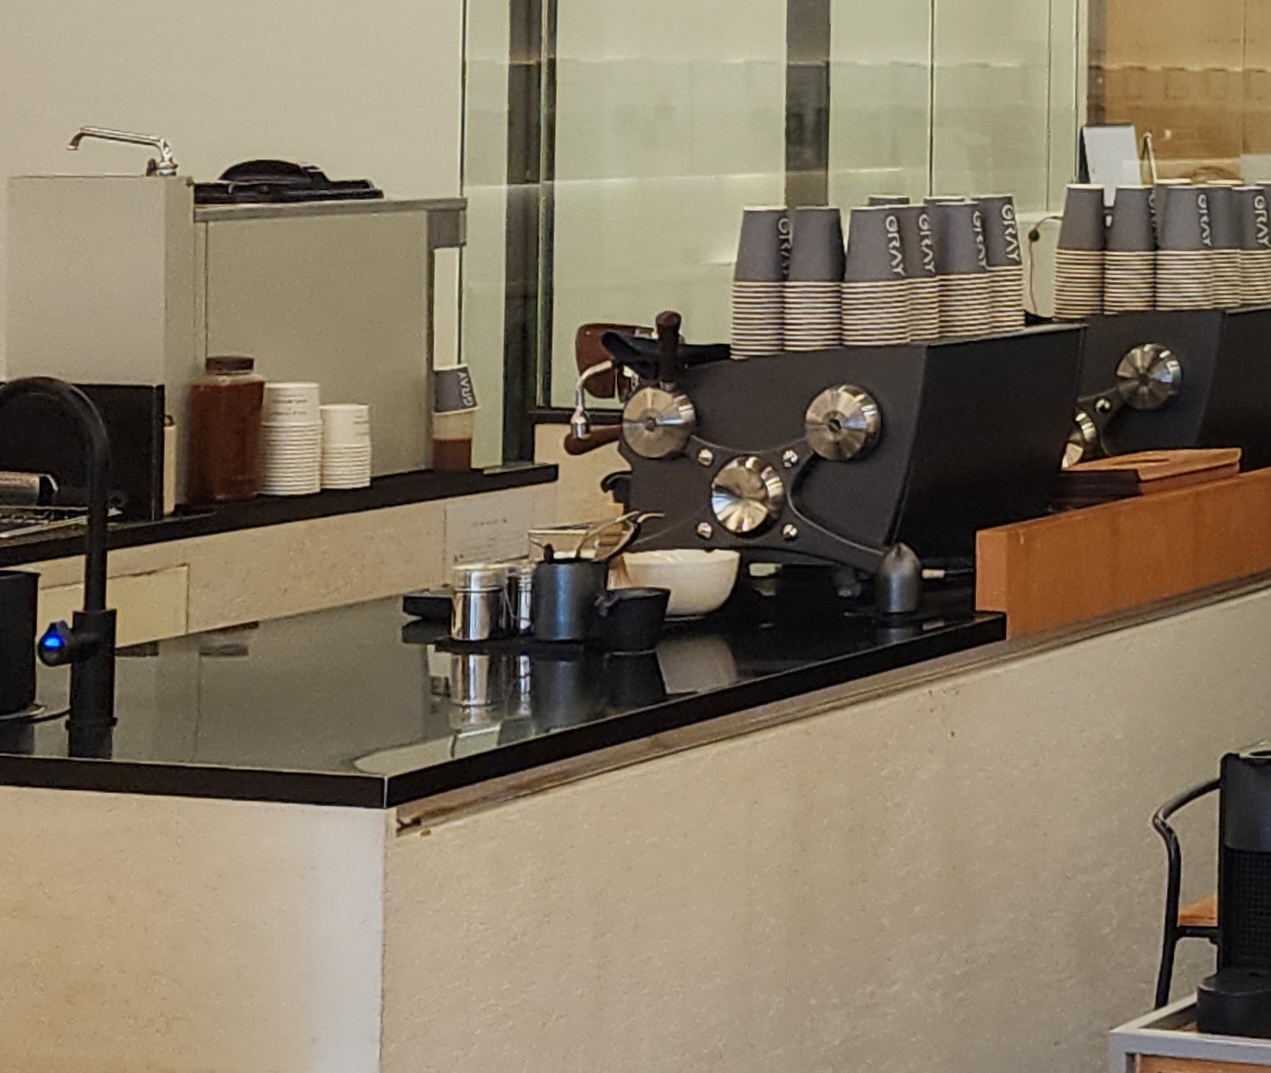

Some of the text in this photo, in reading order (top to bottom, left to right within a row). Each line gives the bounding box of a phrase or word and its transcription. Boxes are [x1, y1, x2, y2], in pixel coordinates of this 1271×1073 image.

[885, 216, 905, 276] GRAY
[919, 213, 936, 273] GRAY
[1002, 204, 1020, 261] GRAY
[1197, 194, 1212, 246] GRAY
[1254, 196, 1270, 245] GRAY
[457, 371, 474, 407] GRAY
